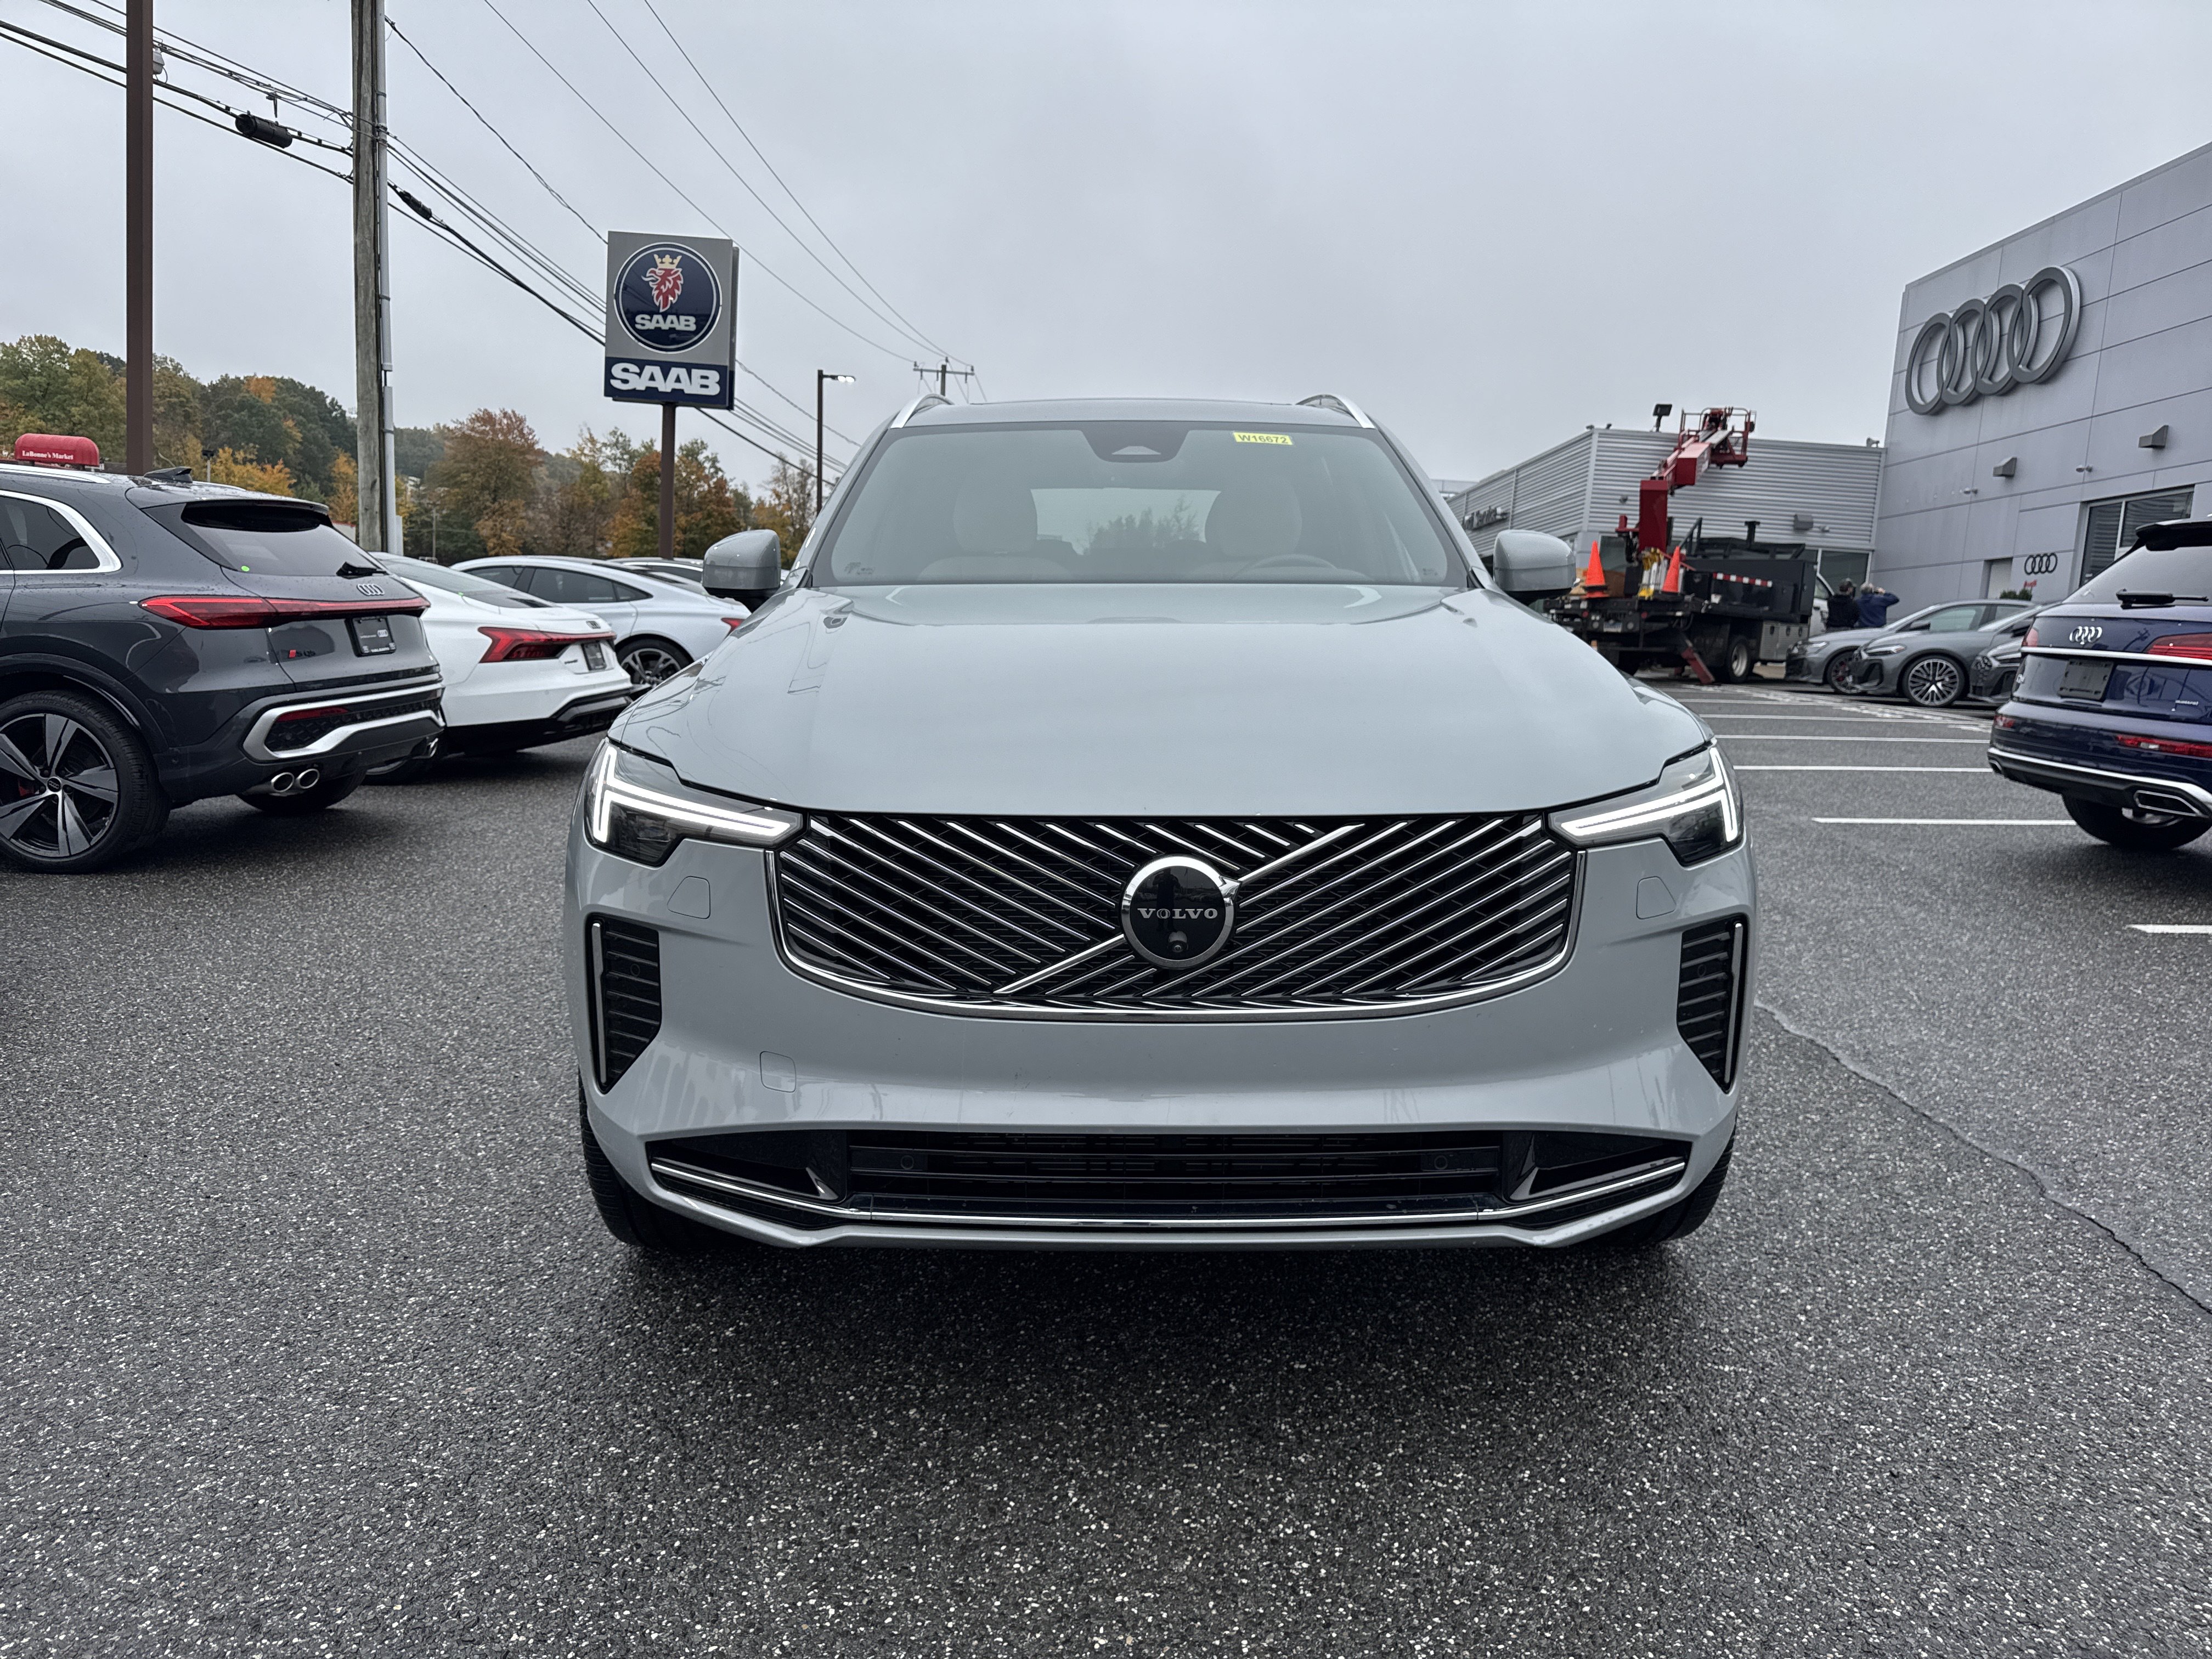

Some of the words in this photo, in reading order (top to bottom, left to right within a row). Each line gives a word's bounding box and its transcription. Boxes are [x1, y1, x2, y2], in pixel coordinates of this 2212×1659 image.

[635, 314, 697, 331] SAAB
[610, 363, 720, 396] SAAB
[1237, 434, 1289, 444] W16672
[1137, 908, 1218, 919] VOLVO
